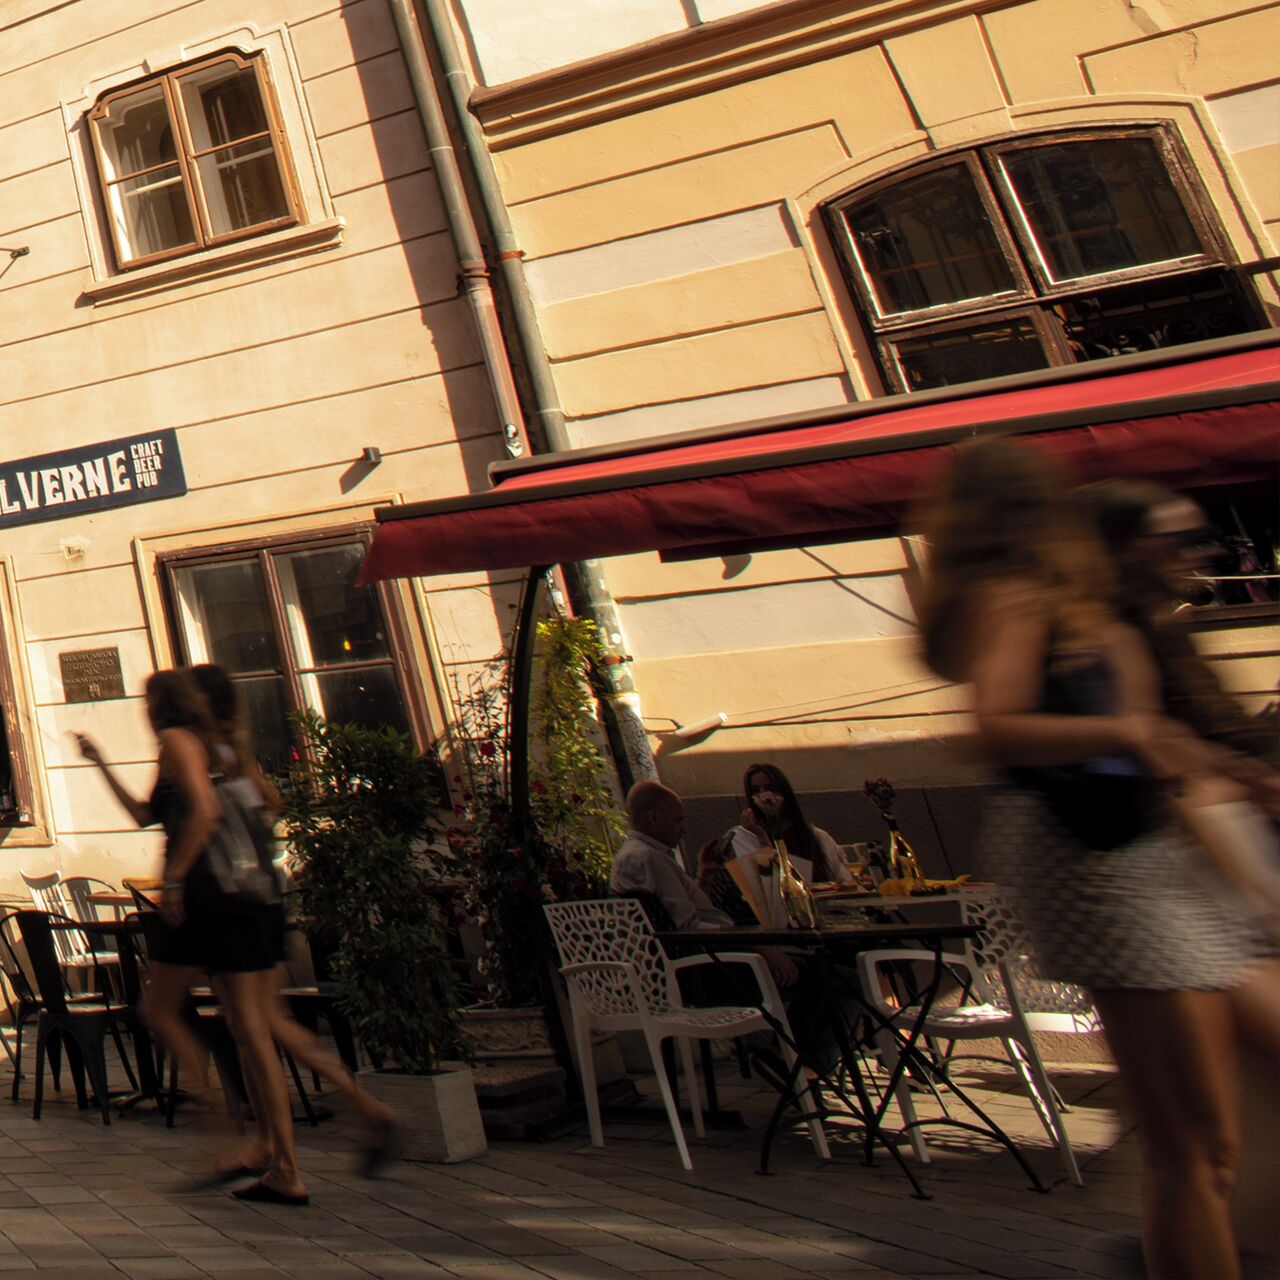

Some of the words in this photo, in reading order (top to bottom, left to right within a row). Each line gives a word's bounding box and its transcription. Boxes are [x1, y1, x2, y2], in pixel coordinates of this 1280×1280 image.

[130, 439, 164, 459] CRAFT
[133, 455, 163, 473] BEER
[16, 449, 132, 510] VERNE
[135, 471, 159, 489] PUB
